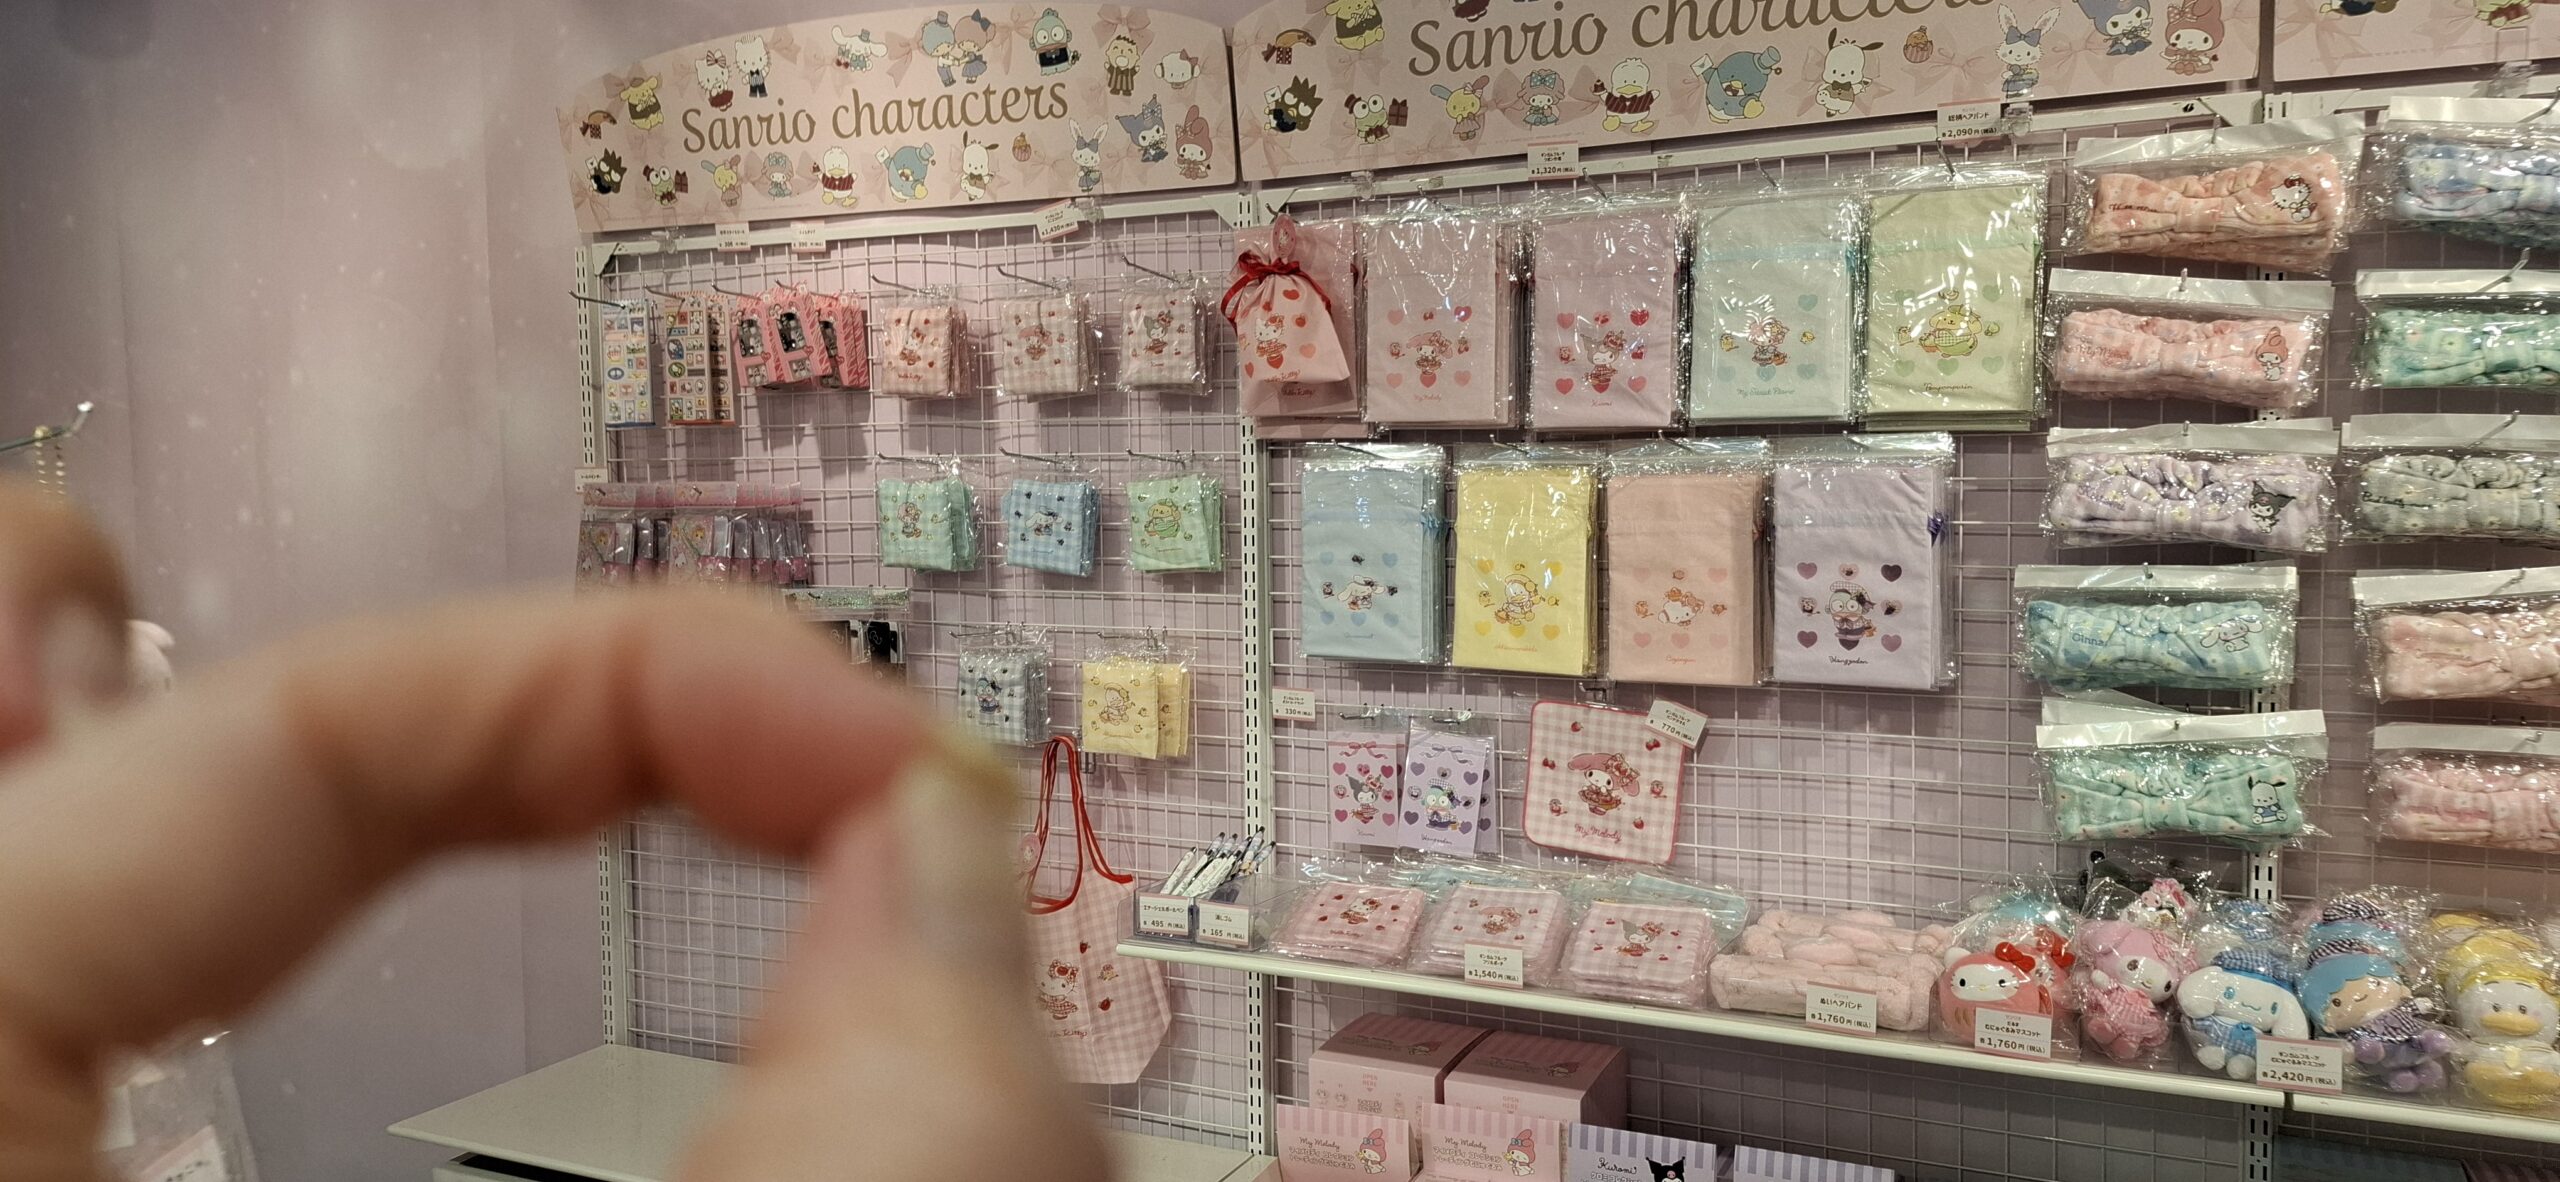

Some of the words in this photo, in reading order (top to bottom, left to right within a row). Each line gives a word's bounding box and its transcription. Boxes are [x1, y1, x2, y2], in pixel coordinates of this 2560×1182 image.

[1408, 0, 1608, 77] Sanrio
[682, 98, 817, 153] Sanrio
[832, 82, 1069, 139] characters
[1574, 822, 1589, 839] My
[1590, 825, 1622, 845] Melody
[1299, 1136, 1313, 1149] My
[1314, 1137, 1340, 1152] Melody
[1444, 1136, 1459, 1149] My
[1460, 1138, 1487, 1153] Melody
[1597, 1157, 1637, 1175] Kuromi
